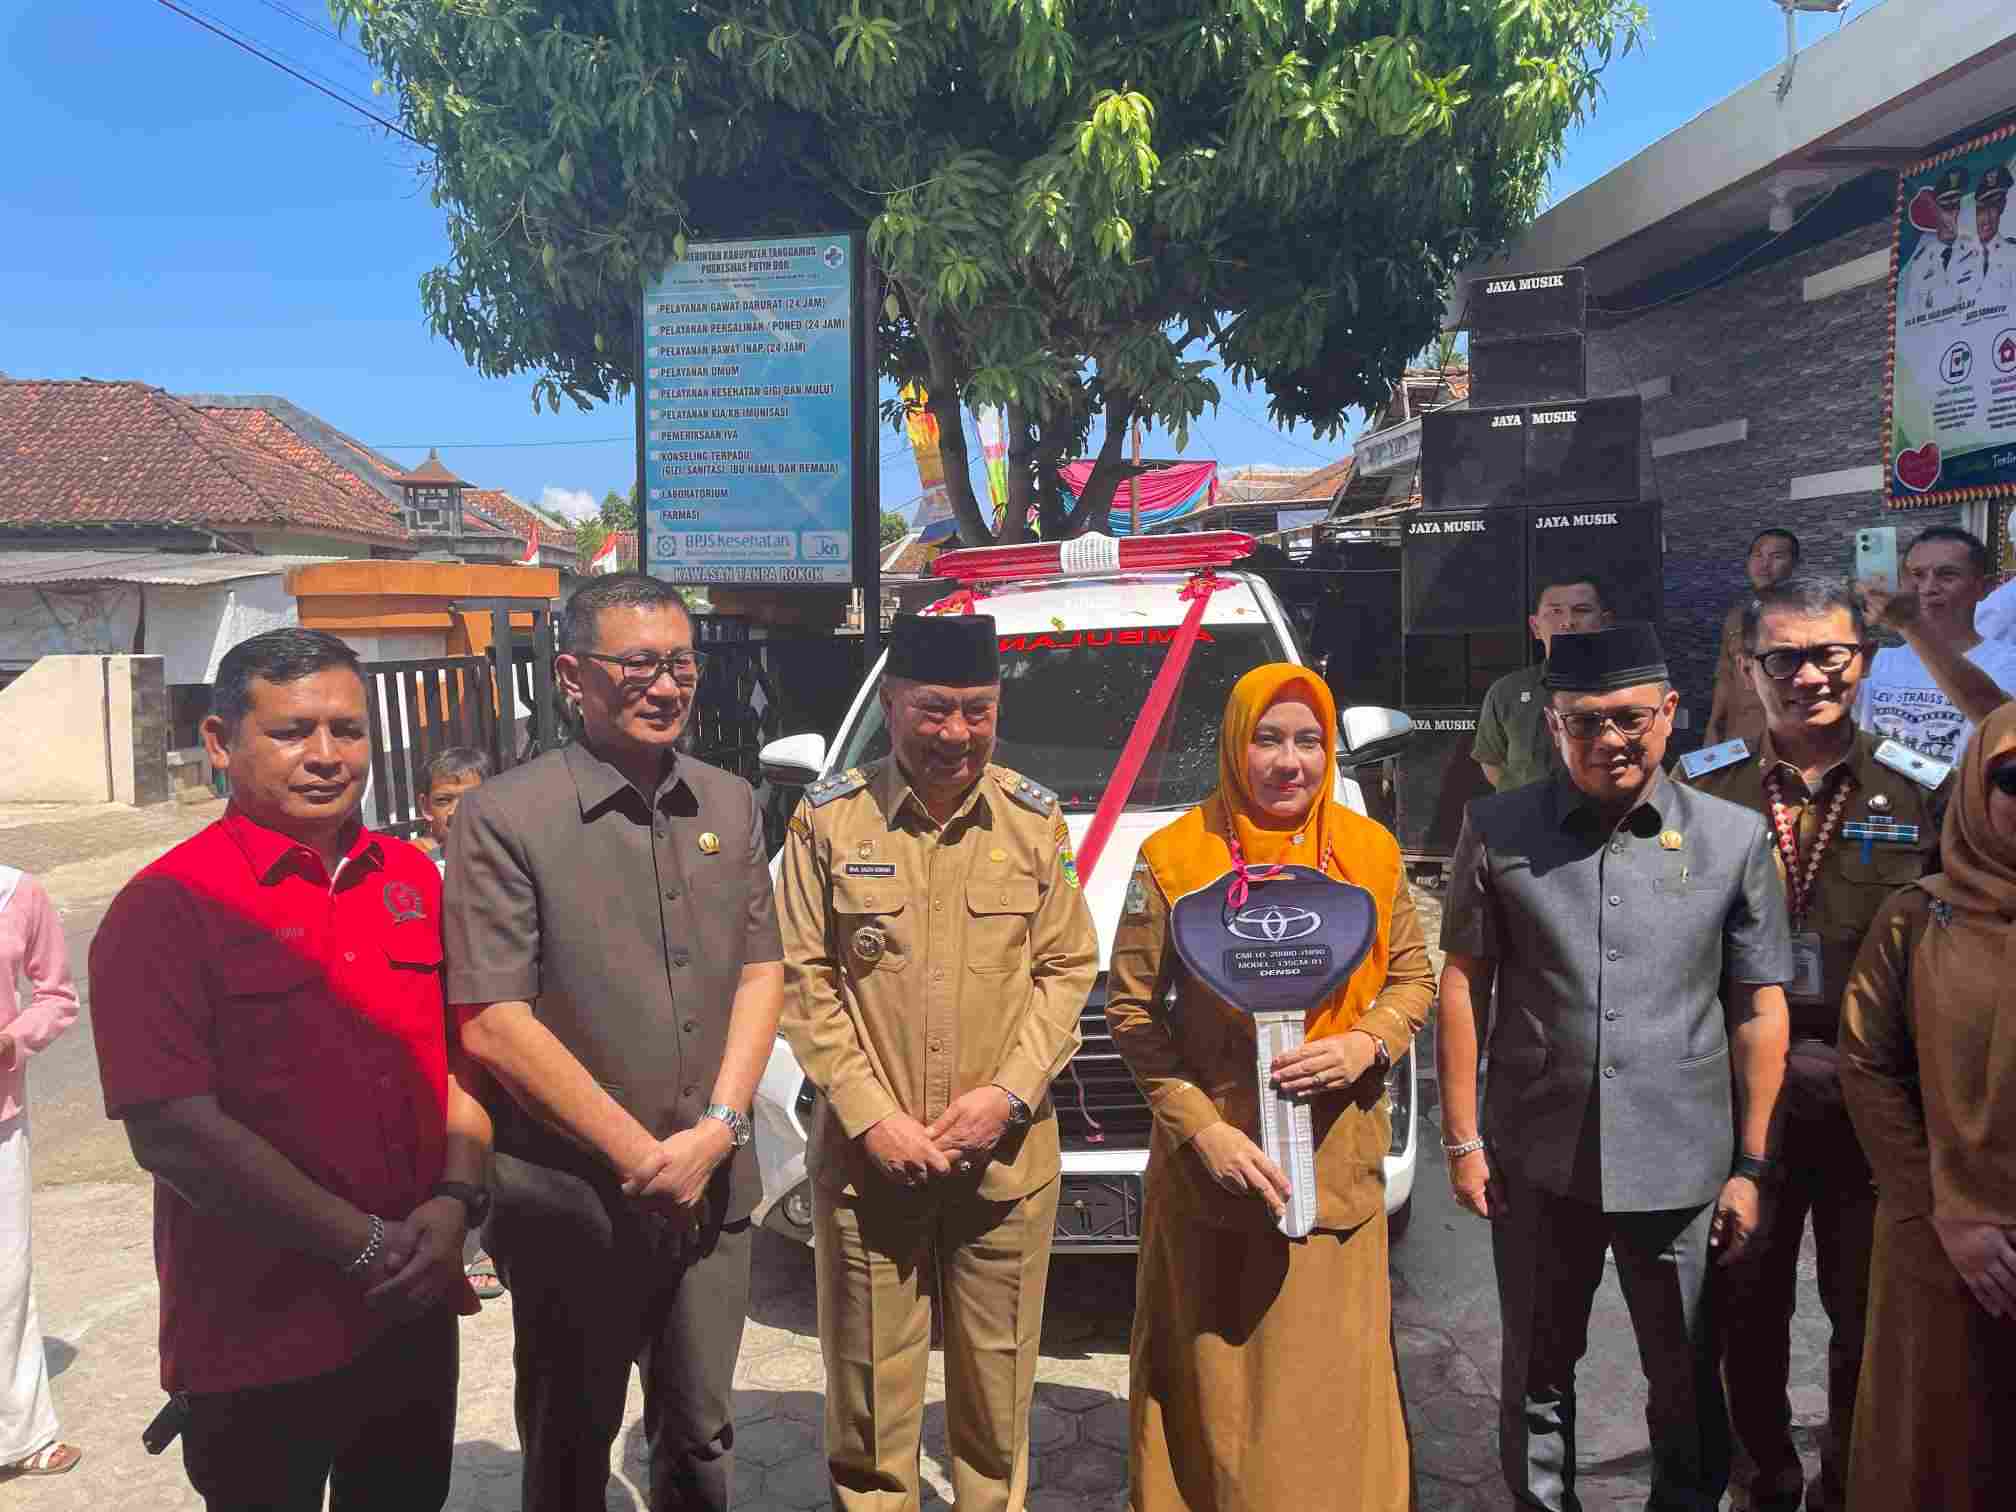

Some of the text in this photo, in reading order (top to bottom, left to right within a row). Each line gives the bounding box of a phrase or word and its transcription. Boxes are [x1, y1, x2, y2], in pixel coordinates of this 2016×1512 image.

[1486, 275, 1564, 294] JAYA MUSIK
[659, 302, 708, 314] PELAYANAN
[710, 301, 740, 312] GAWAT
[743, 300, 782, 311] DARURAT
[659, 325, 710, 336] PELAYANAN
[710, 322, 765, 334] PERSALINAN
[772, 320, 802, 331] PONED
[660, 346, 709, 357] PELAYANAN
[711, 345, 740, 355] RAWAT
[743, 344, 763, 354] INAP
[660, 366, 739, 378] PELAYANAN UMUM
[660, 384, 834, 400] PELAYANAN KESEHATAN GIGI DAN MULUT
[660, 409, 710, 420] PELAYANAN
[743, 407, 789, 418] IMUNISASI
[1491, 410, 1577, 427] JAYA MUSIK
[661, 431, 738, 442] PEMERIKSAAN IVA
[661, 450, 752, 461] KONSELING TERPADU
[778, 463, 797, 473] DAN
[661, 487, 729, 499] LABORATORIUM
[661, 509, 700, 520] FARMASI
[1535, 513, 1618, 529] JAYA MUSIK
[1409, 520, 1486, 534] JAYA MUSIK
[685, 533, 791, 550] BPJS Kesehatan
[674, 567, 825, 582] KAWASAN TANPA ROKOK
[1434, 720, 1477, 730] MUSIK
[1259, 968, 1301, 976] DENSO
